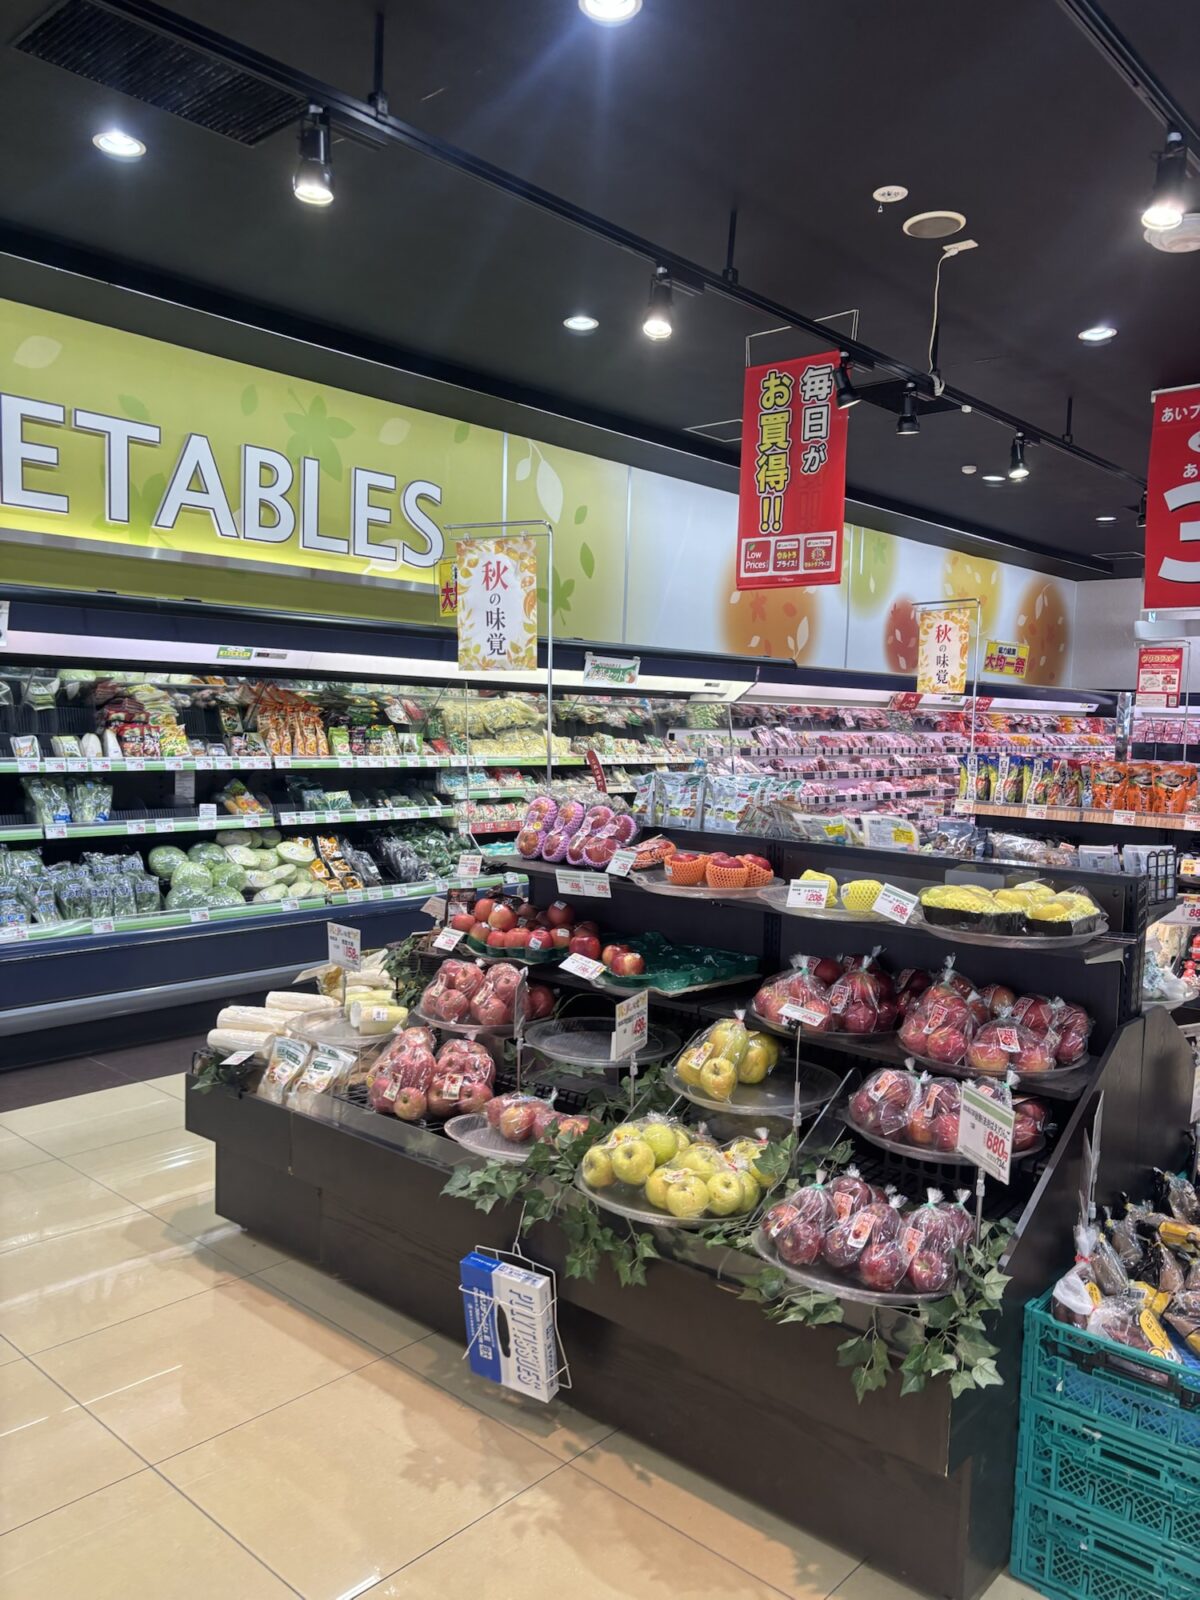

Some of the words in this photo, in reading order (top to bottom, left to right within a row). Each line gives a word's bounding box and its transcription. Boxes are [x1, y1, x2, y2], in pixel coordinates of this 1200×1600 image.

[799, 364, 834, 475] 毎日が
[746, 551, 762, 559] Low
[481, 559, 509, 656] 秋の味覚
[935, 624, 952, 684] 秋の味覚
